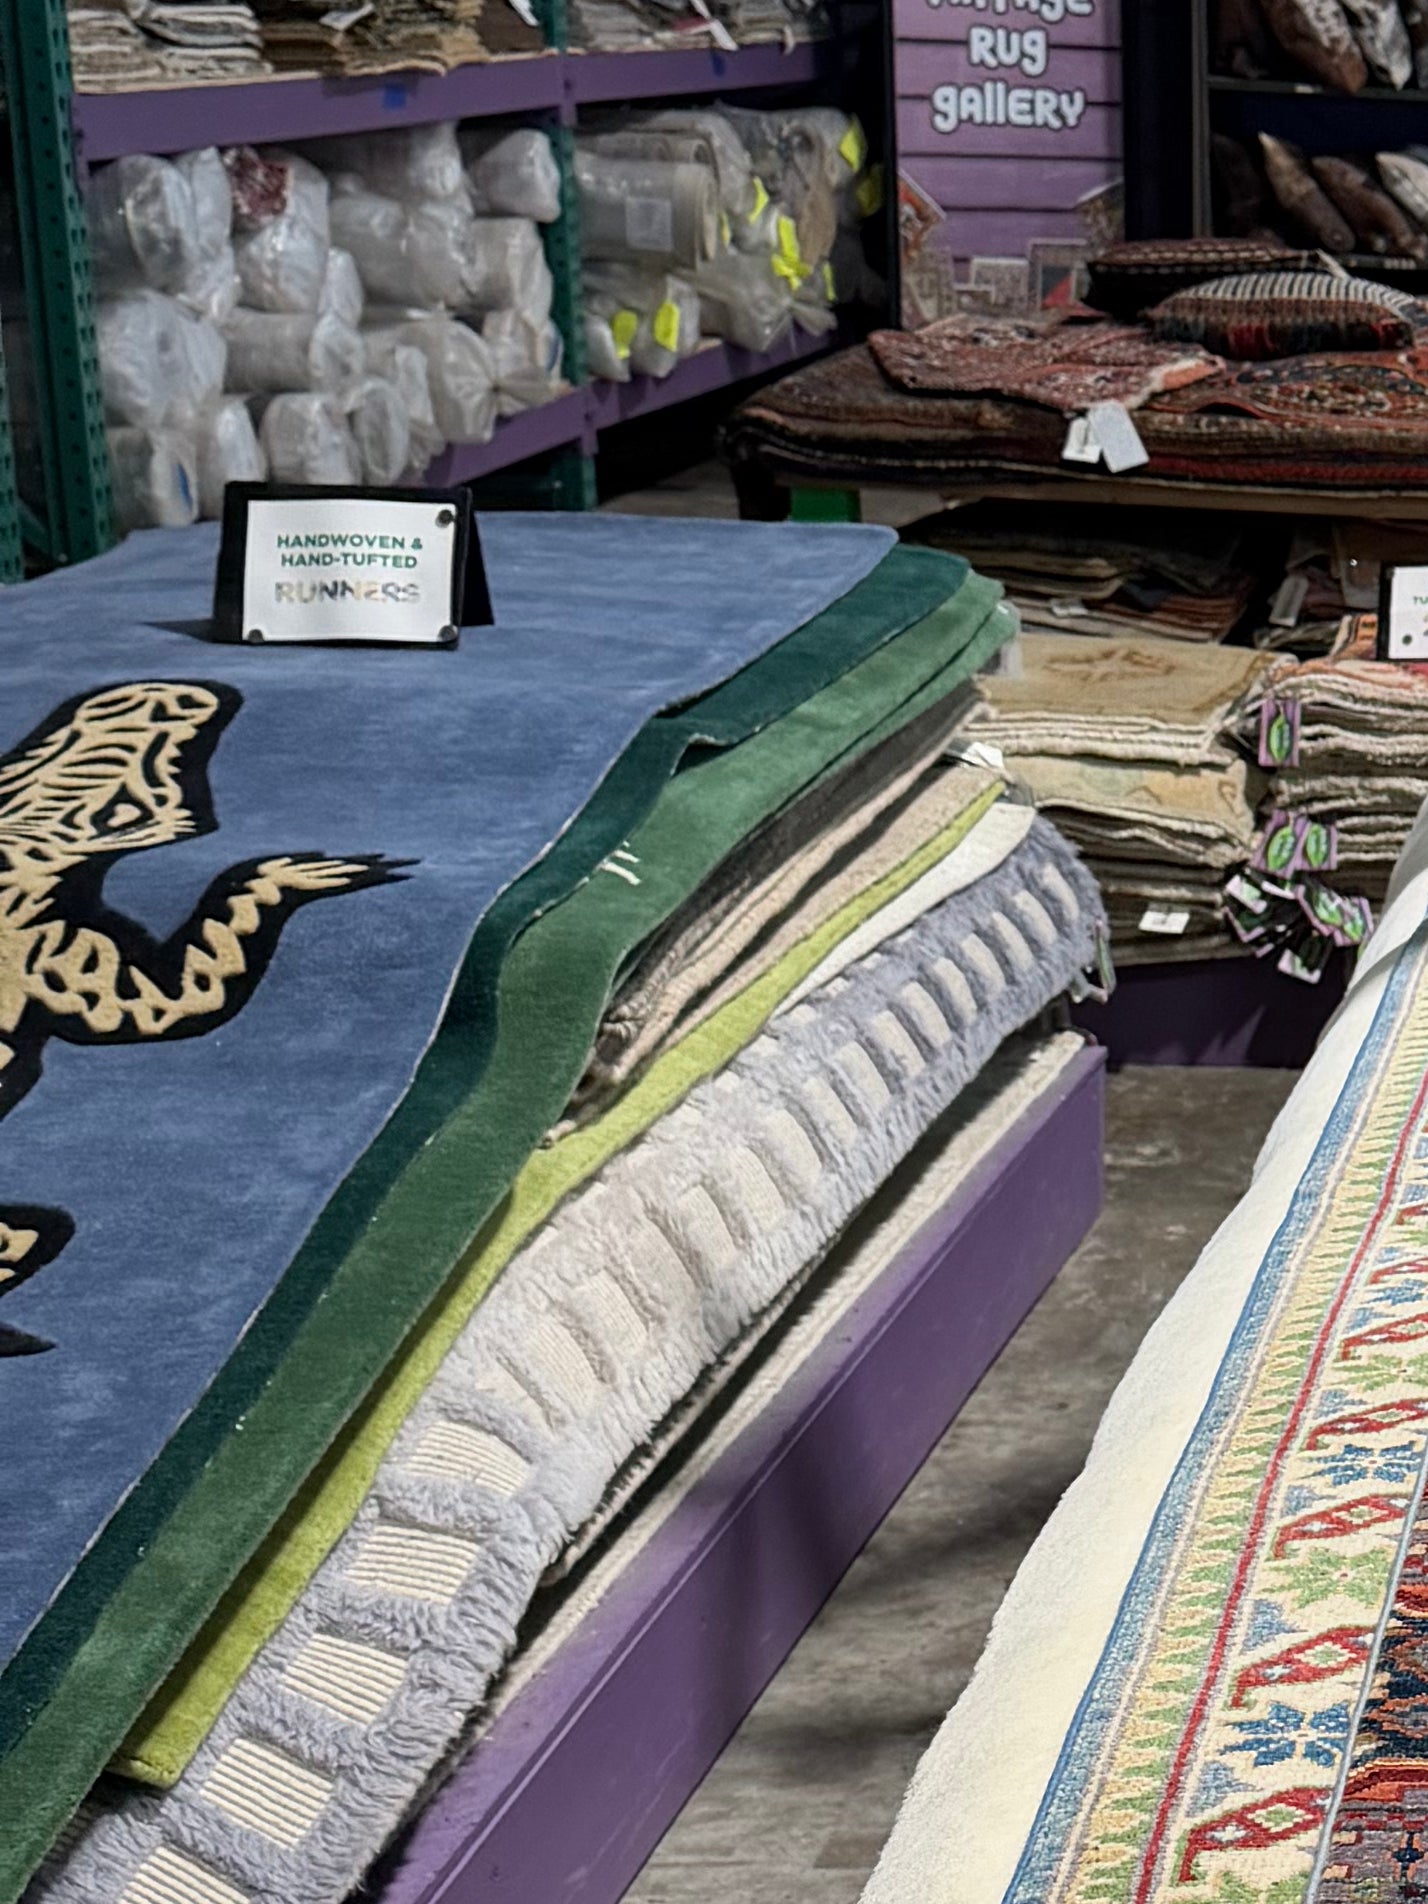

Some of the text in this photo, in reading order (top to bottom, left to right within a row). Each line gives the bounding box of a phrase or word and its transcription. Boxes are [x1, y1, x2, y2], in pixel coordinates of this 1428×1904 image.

[276, 533, 423, 550] HANDWOVEN &
[281, 552, 417, 568] HAND-TUFTED
[275, 579, 421, 603] RUNNERS
